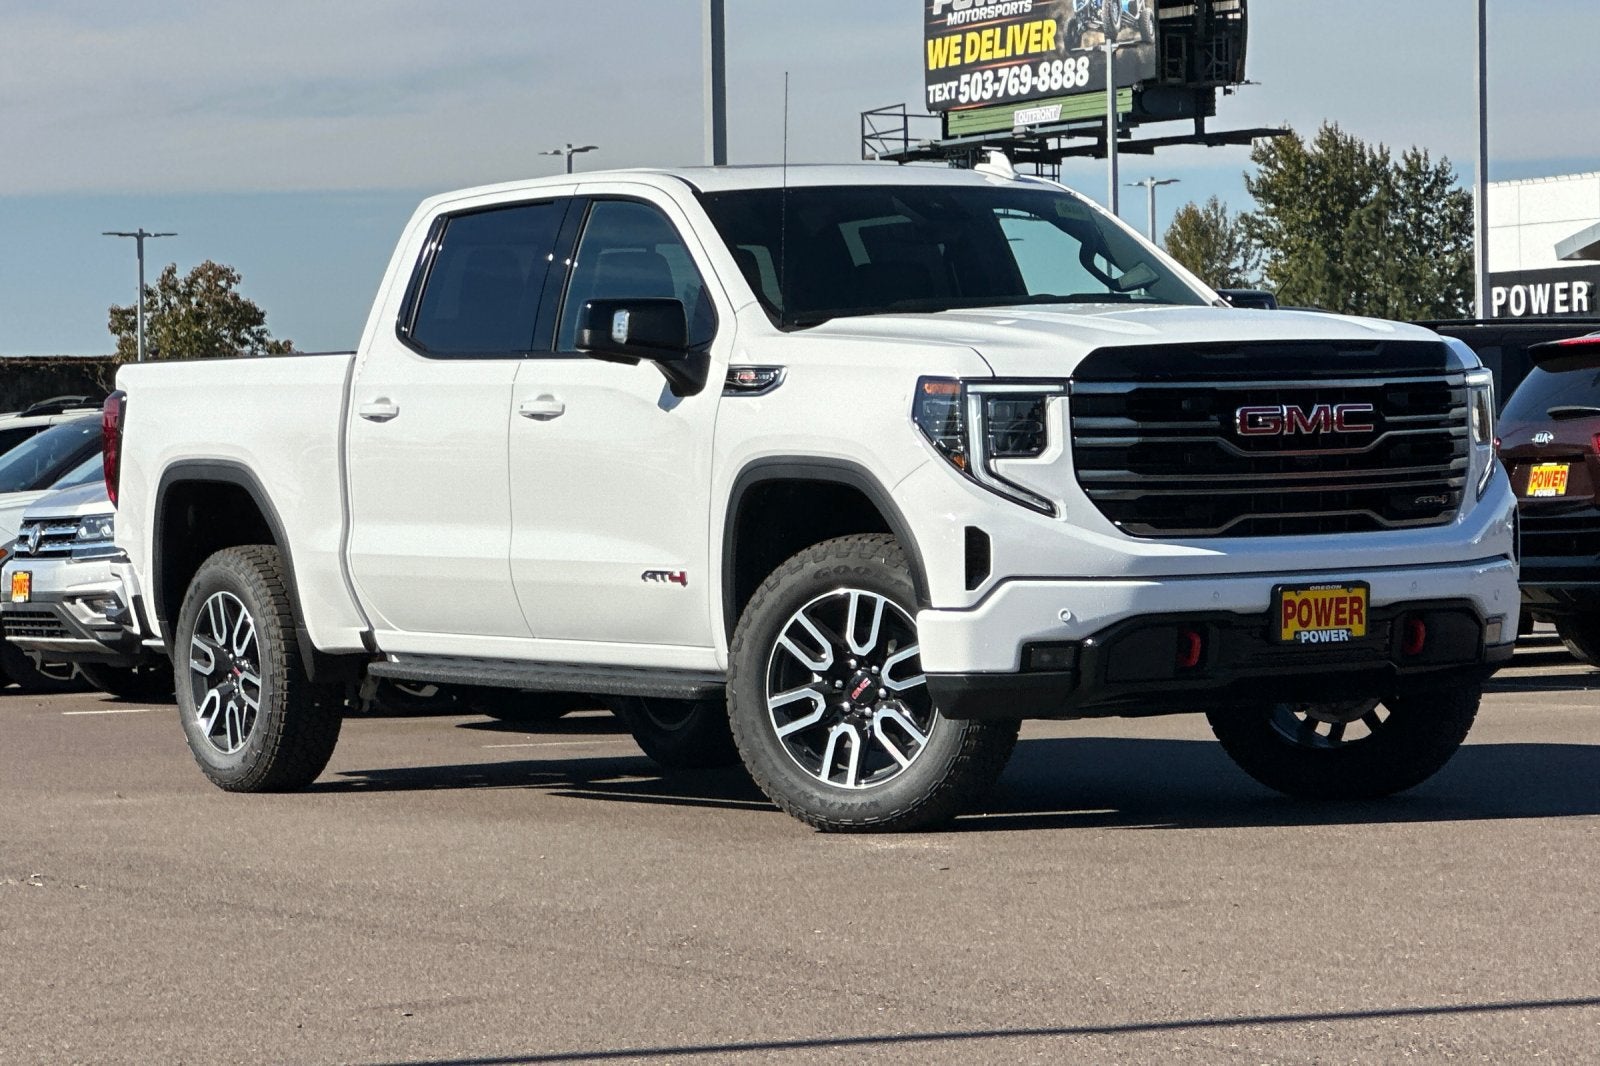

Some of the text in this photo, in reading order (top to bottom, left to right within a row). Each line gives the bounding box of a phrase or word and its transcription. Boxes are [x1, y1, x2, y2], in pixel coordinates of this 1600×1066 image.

[946, 0, 1032, 26] MOTORSPORTS
[927, 19, 1057, 71] WE DELIVER
[927, 56, 1090, 104] TEXT 503-769-8888
[1018, 107, 1058, 123] OUTFRONT
[1491, 281, 1588, 318] POWER
[1235, 403, 1374, 436] GMC
[1530, 470, 1567, 488] POWER
[641, 570, 689, 588] AT4
[1282, 596, 1364, 629] POWER
[1300, 629, 1349, 644] POWER
